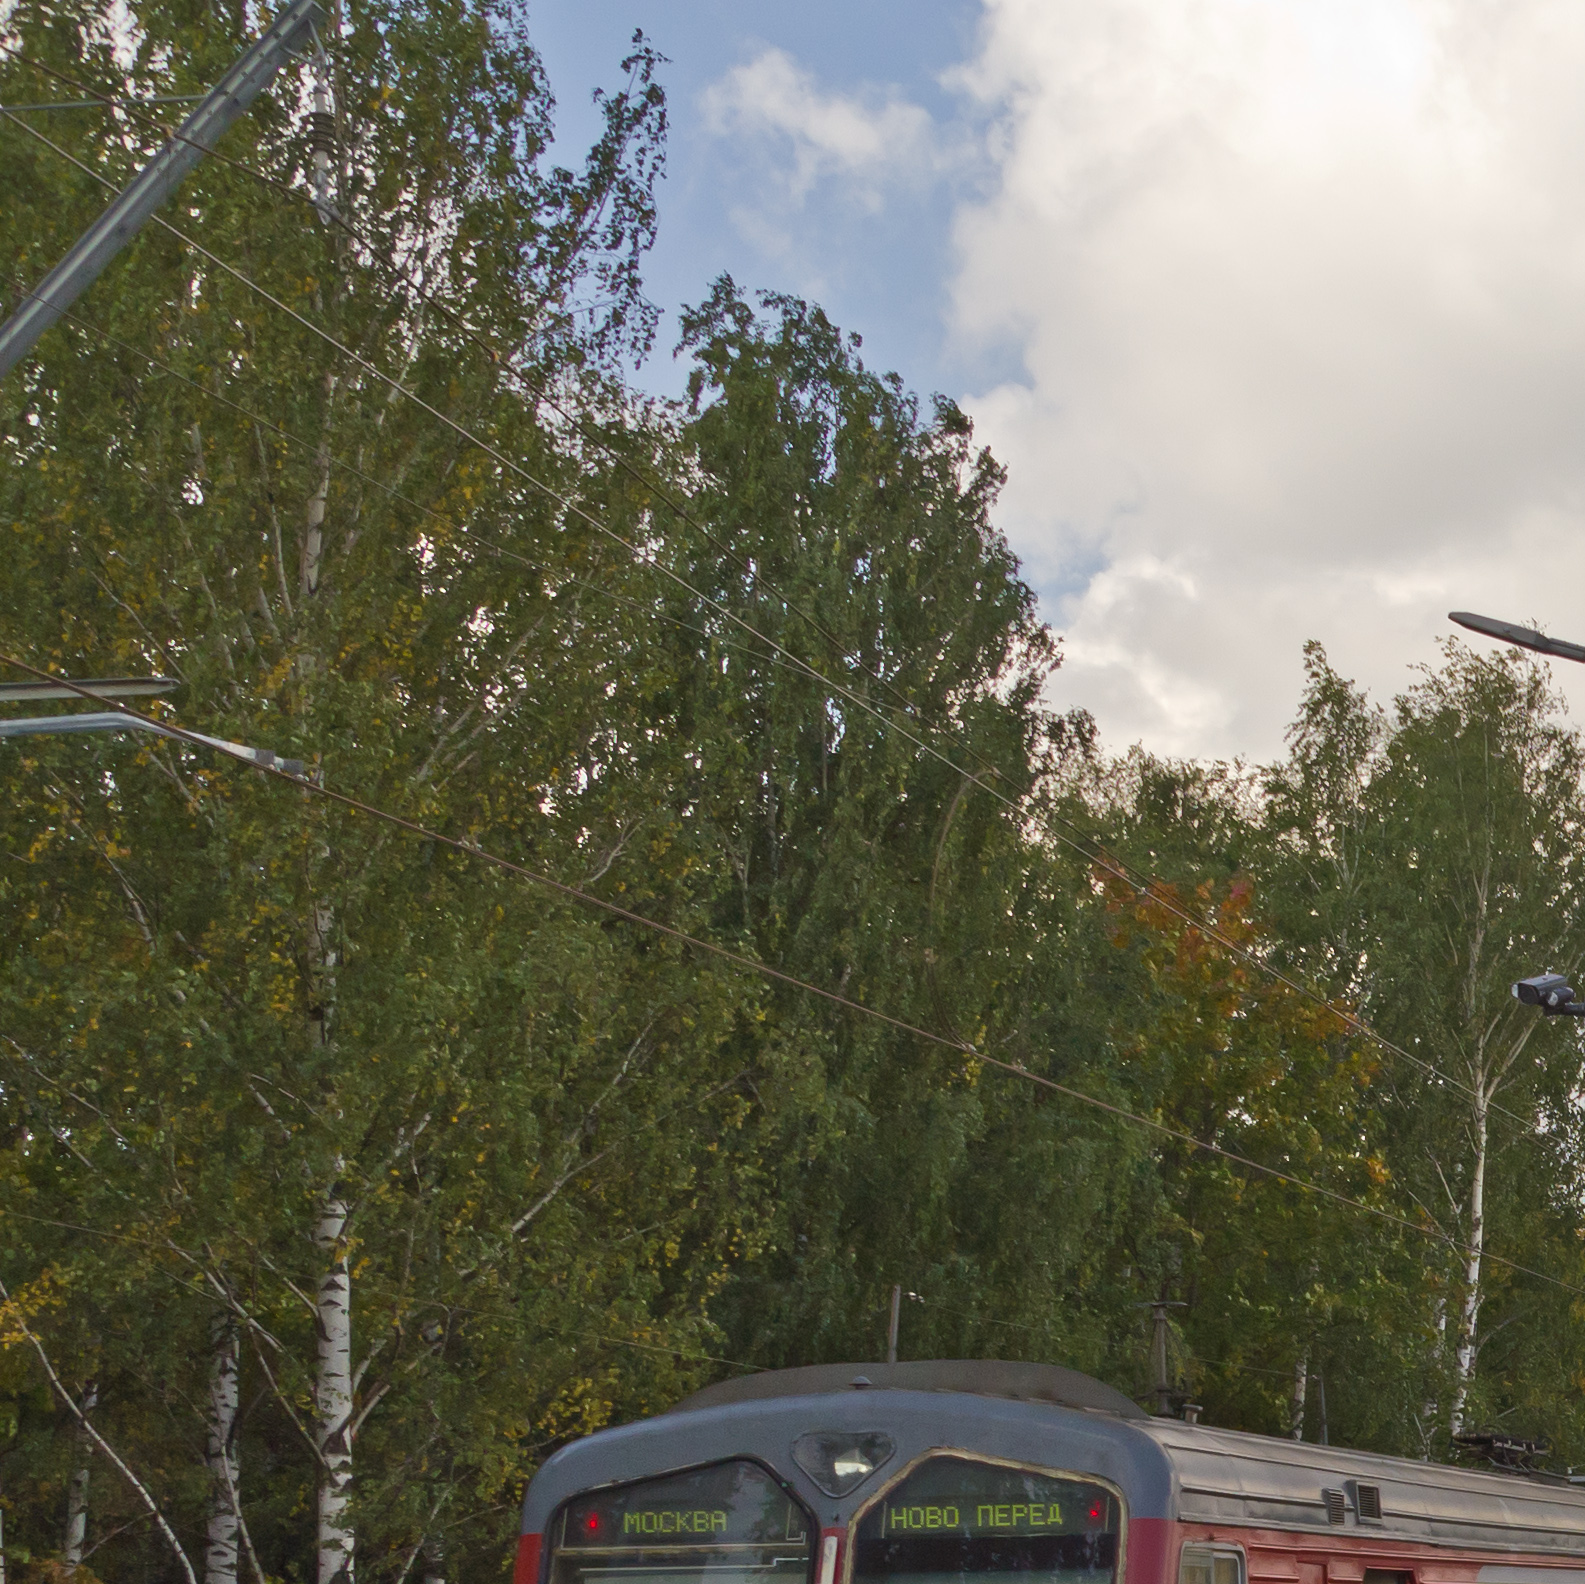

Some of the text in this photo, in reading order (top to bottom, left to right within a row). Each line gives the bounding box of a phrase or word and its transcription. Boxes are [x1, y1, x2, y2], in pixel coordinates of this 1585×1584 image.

[623, 1510, 727, 1534] МОСКВА
[890, 1503, 1063, 1529] НОВО ПЕРЕД
